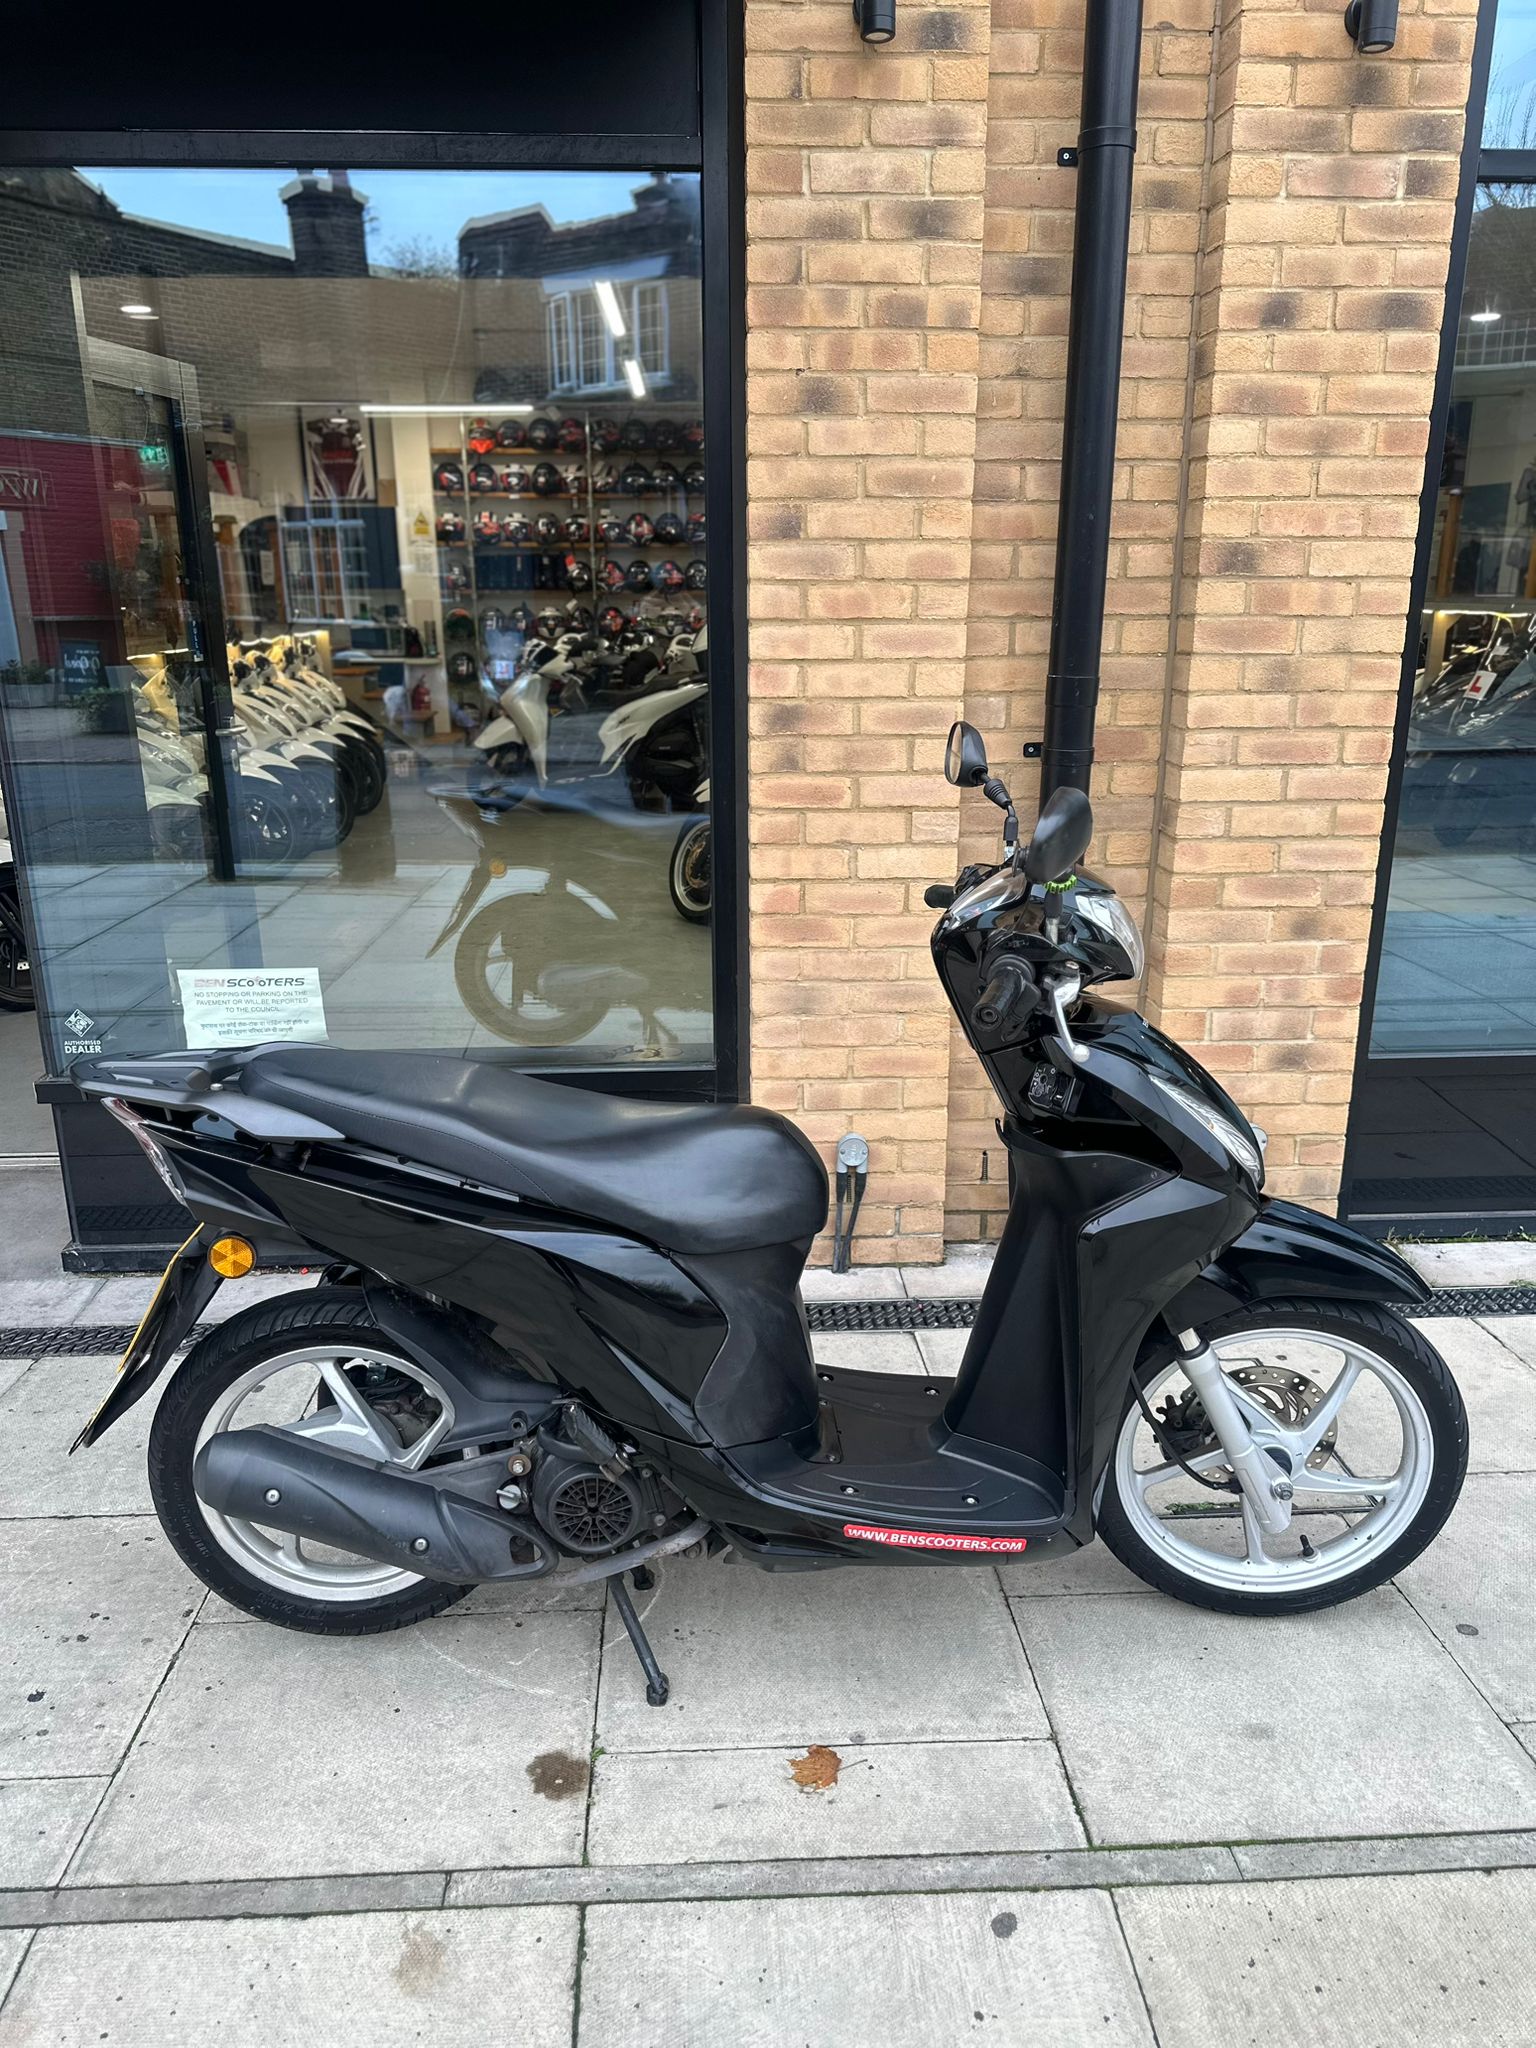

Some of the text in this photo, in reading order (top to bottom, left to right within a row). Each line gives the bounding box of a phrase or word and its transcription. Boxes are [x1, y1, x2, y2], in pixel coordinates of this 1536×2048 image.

[1469, 675, 1482, 693] L
[282, 990, 293, 998] ON
[271, 997, 308, 1005] REPORTED
[64, 1045, 102, 1054] DEALER
[847, 1528, 1023, 1551] WWW.BENSCOOTERS.COM
